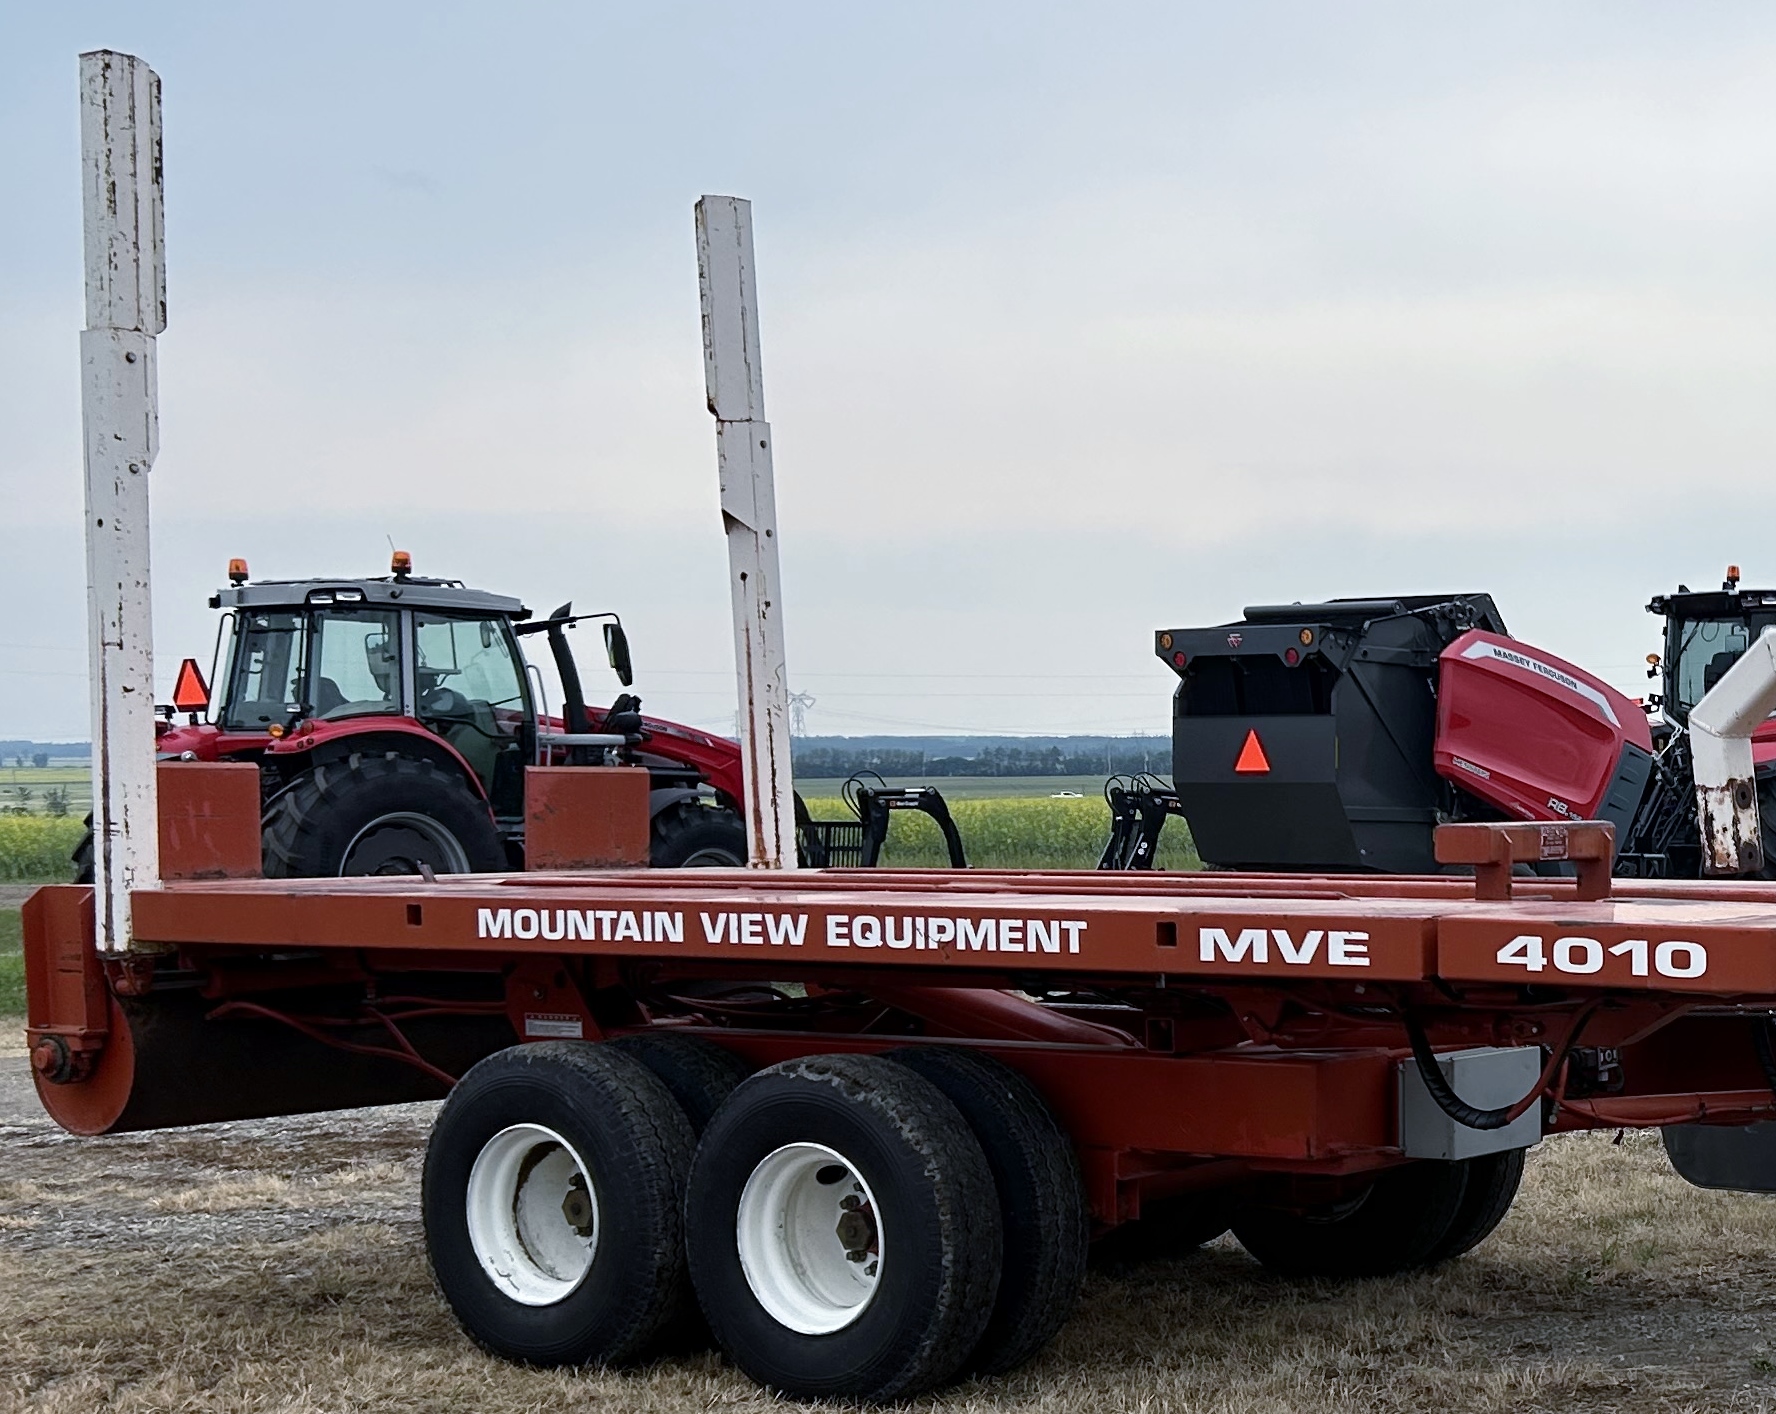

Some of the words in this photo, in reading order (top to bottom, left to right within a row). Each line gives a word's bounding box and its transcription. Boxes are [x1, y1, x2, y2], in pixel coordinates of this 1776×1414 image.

[1493, 648, 1530, 667] MASSEY
[1533, 662, 1578, 689] FERGUSON
[477, 908, 684, 943] MOUNTAIN
[699, 912, 808, 946] VIEW
[826, 914, 1088, 954] EQUIPMENT
[1199, 927, 1371, 967] MVE
[1496, 935, 1708, 979] 4010
